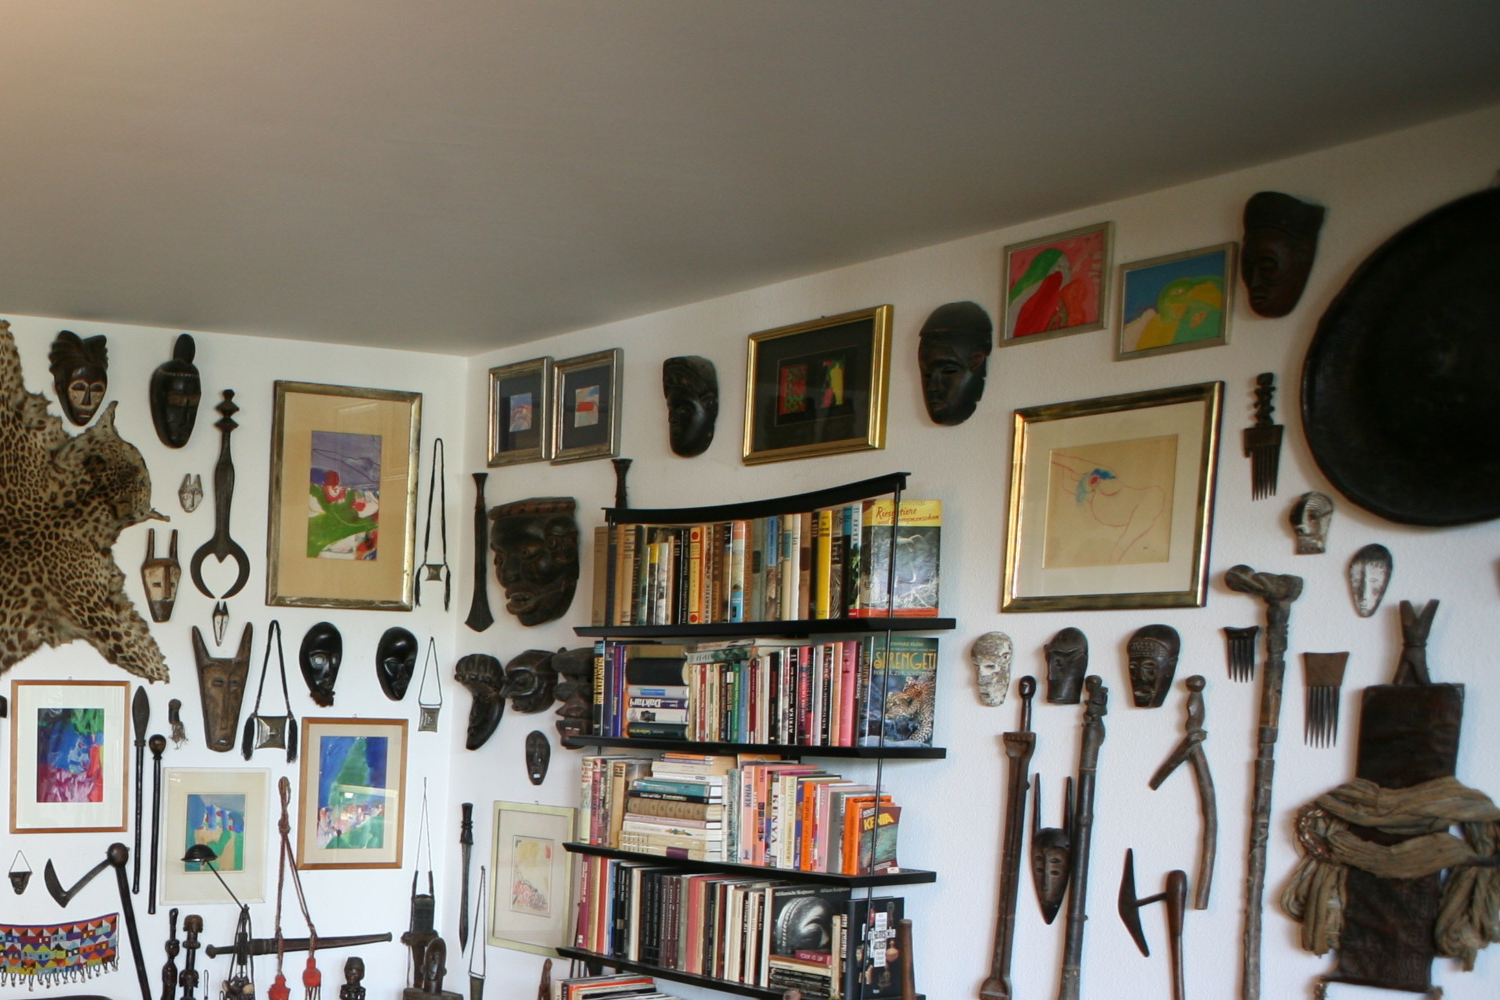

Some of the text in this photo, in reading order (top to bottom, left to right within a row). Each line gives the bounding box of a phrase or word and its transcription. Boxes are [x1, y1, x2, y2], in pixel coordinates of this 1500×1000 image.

[876, 506, 917, 519] Riesetiere
[890, 514, 940, 525] Zergmenschen
[597, 657, 605, 693] ELEFANTEN
[629, 698, 661, 708] Daktari
[745, 784, 753, 808] KENIA
[863, 812, 895, 831] KENIA
